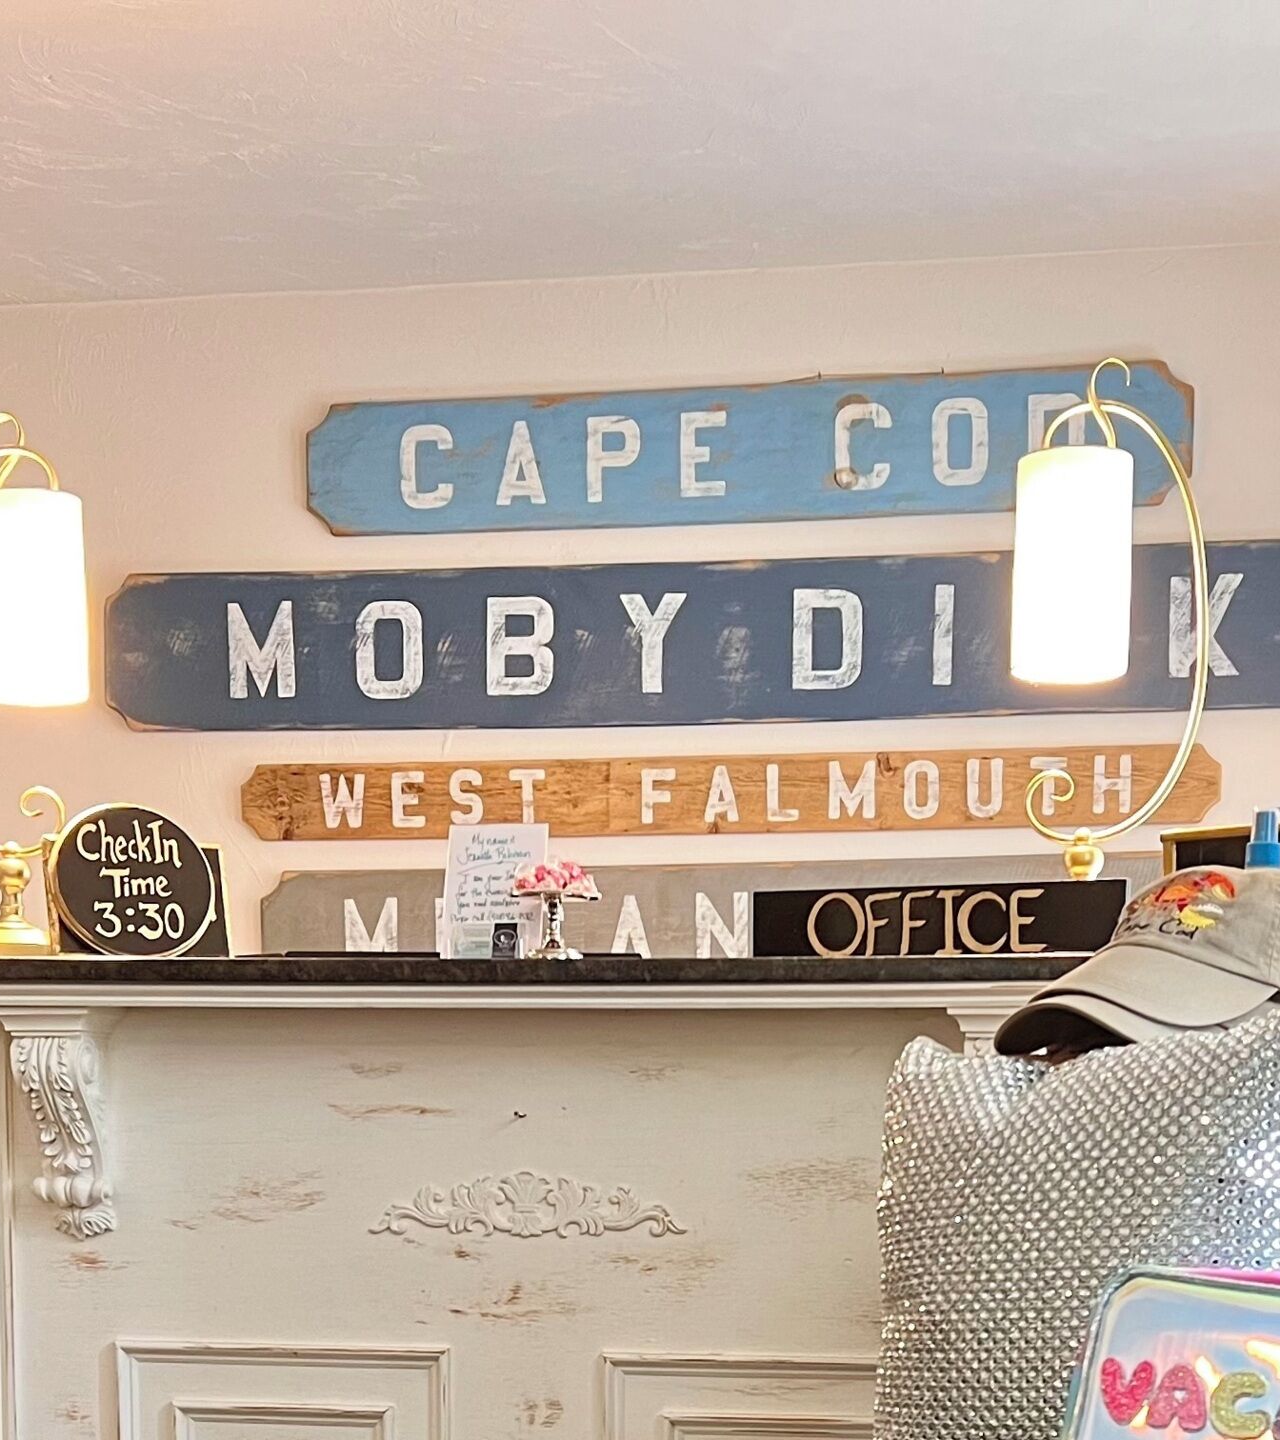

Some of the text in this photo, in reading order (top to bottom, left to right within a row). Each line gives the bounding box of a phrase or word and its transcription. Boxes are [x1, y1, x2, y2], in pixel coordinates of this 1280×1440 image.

[400, 411, 727, 509] CAPE
[227, 572, 1244, 699] MOBY DIK
[319, 754, 1132, 829] WEST FALMOUTH
[99, 866, 173, 899] Time
[93, 900, 185, 940] 3:30
[343, 891, 749, 960] MAN
[808, 888, 1048, 958] OFFICE
